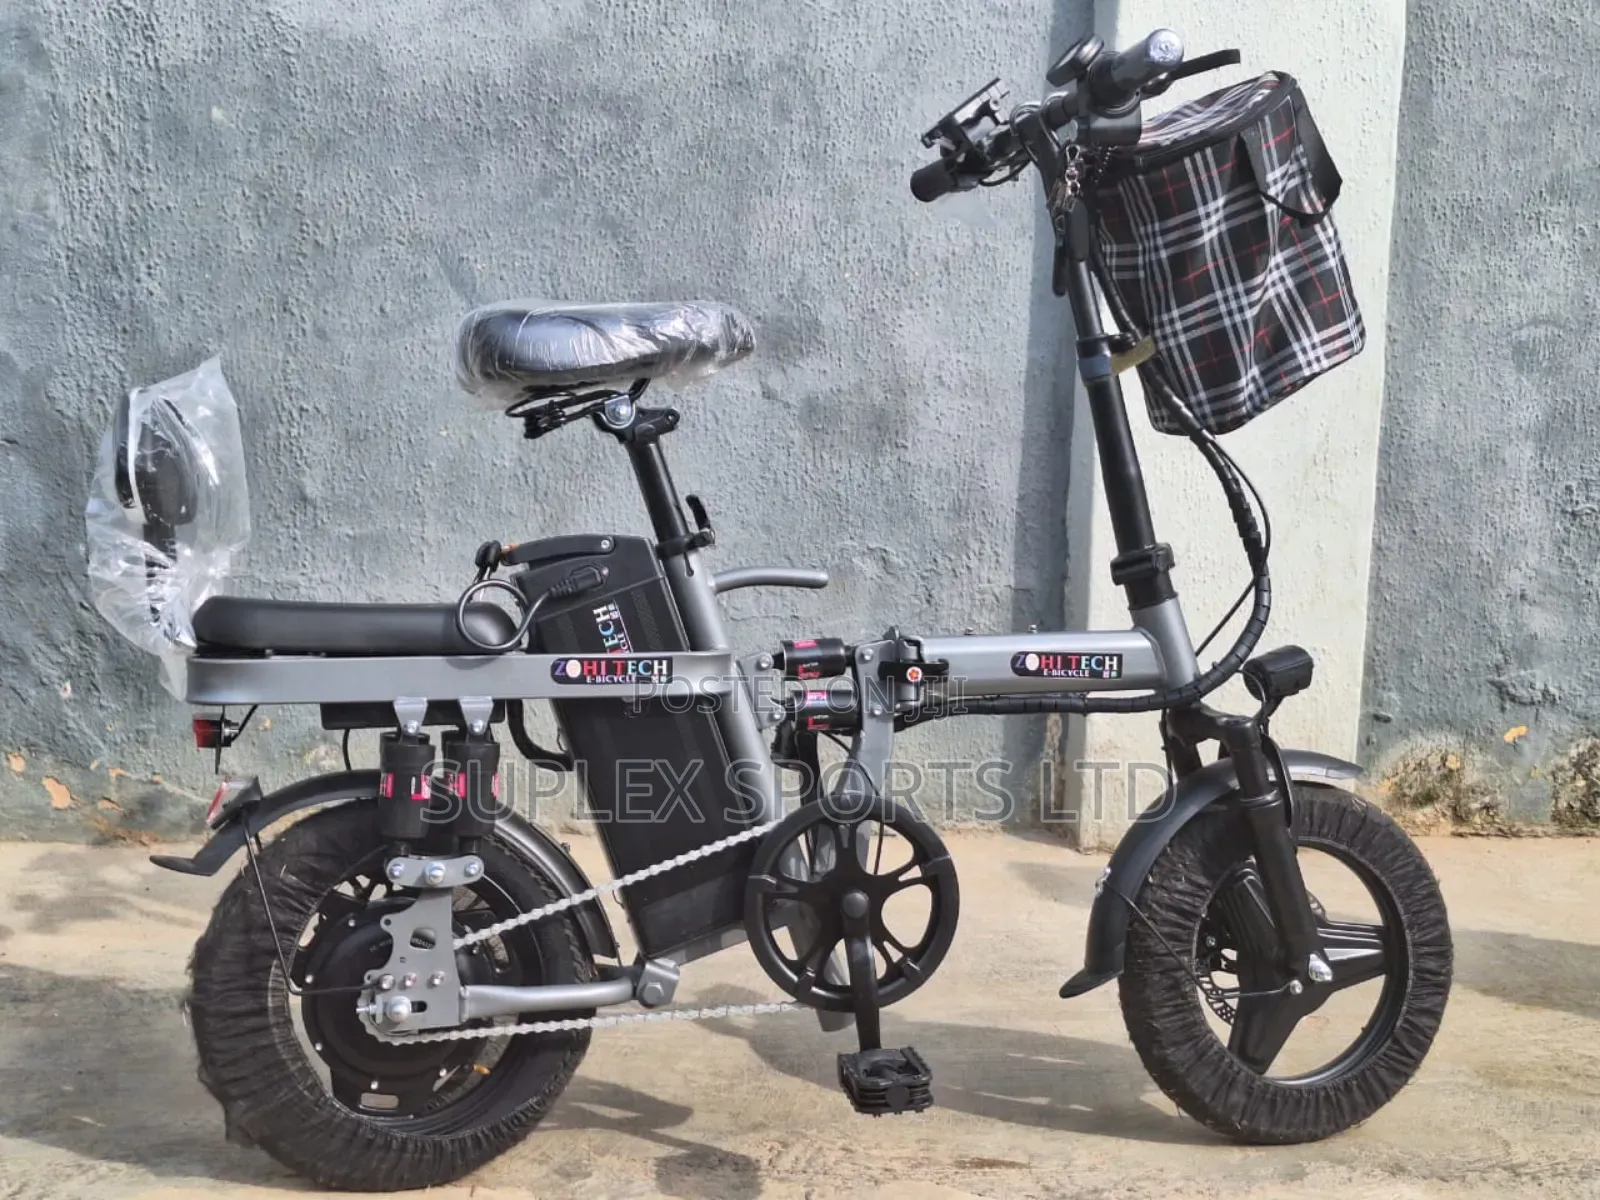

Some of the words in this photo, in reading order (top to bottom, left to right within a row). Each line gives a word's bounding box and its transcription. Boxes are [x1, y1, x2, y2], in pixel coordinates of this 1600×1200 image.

[593, 604, 622, 654] ECH
[612, 659, 668, 676] TECH
[1067, 655, 1118, 671] TECH
[1043, 668, 1090, 677] E-BICYCLE
